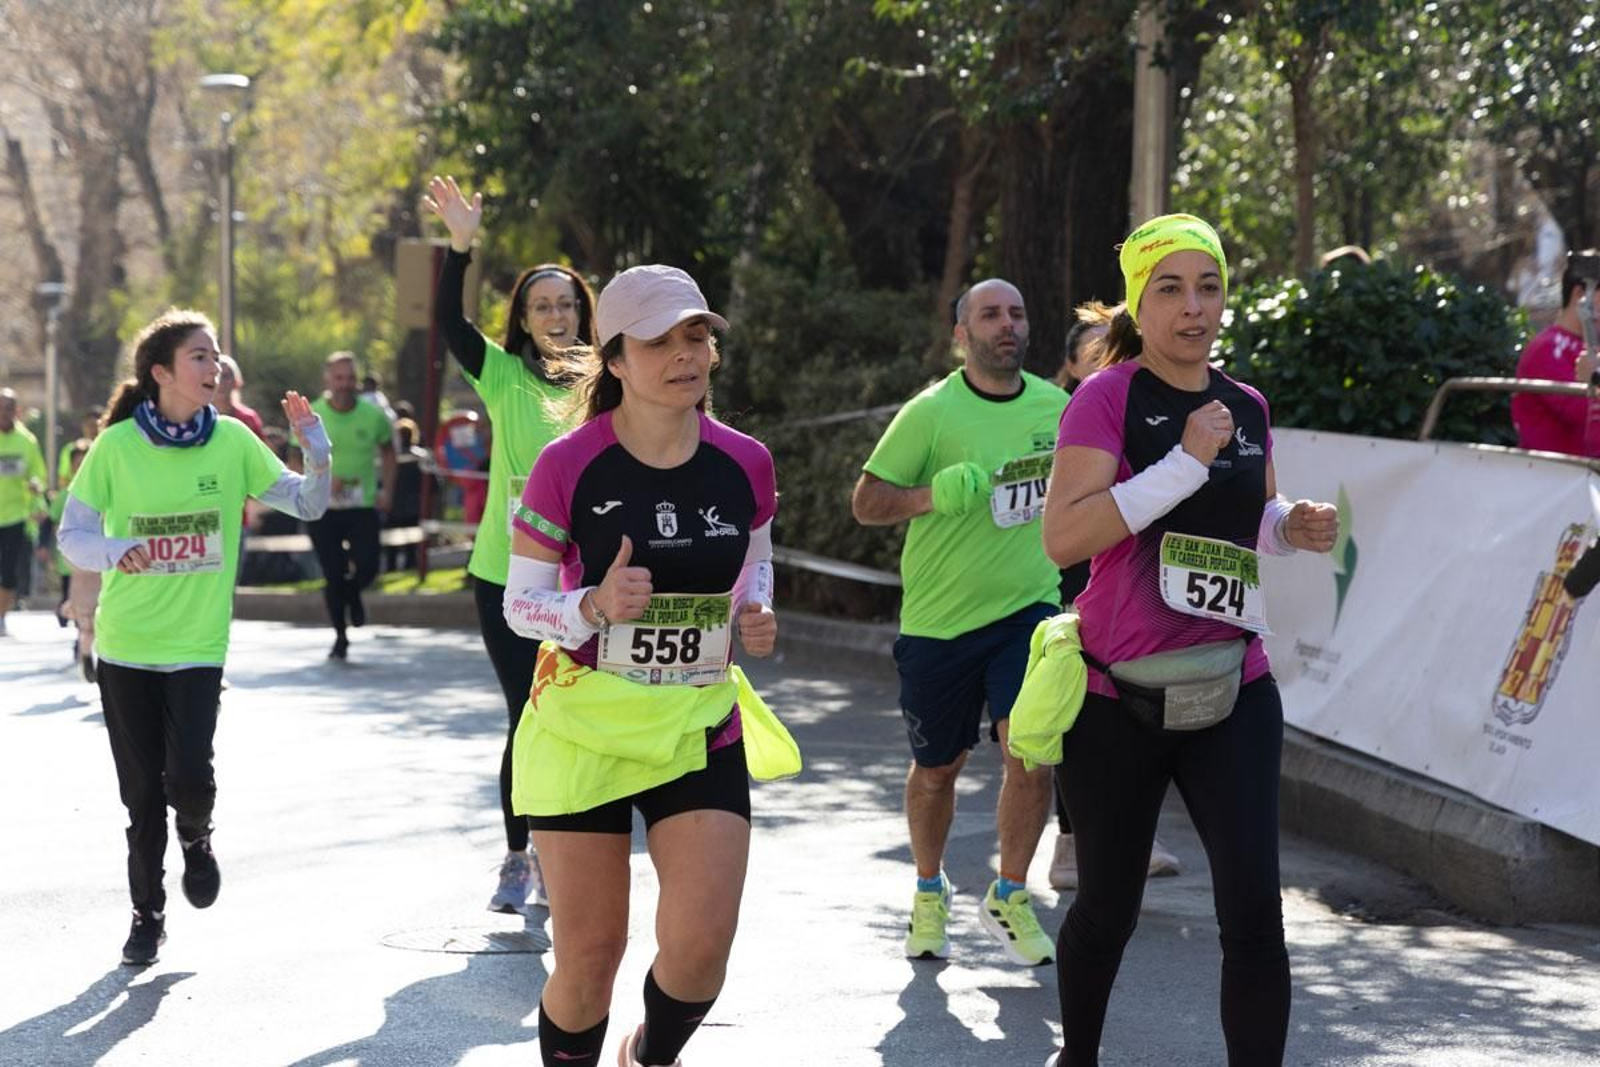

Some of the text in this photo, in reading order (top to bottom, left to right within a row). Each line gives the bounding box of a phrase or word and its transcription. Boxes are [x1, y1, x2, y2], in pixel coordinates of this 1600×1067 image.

[148, 534, 206, 561] 1024
[1184, 539, 1199, 552] SAN
[1203, 541, 1221, 555] JUAN
[1178, 551, 1207, 568] CARRERA
[1210, 555, 1237, 571] POPULAR
[1186, 572, 1245, 617] 524
[657, 609, 689, 624] POPULAR
[630, 627, 702, 665] 558
